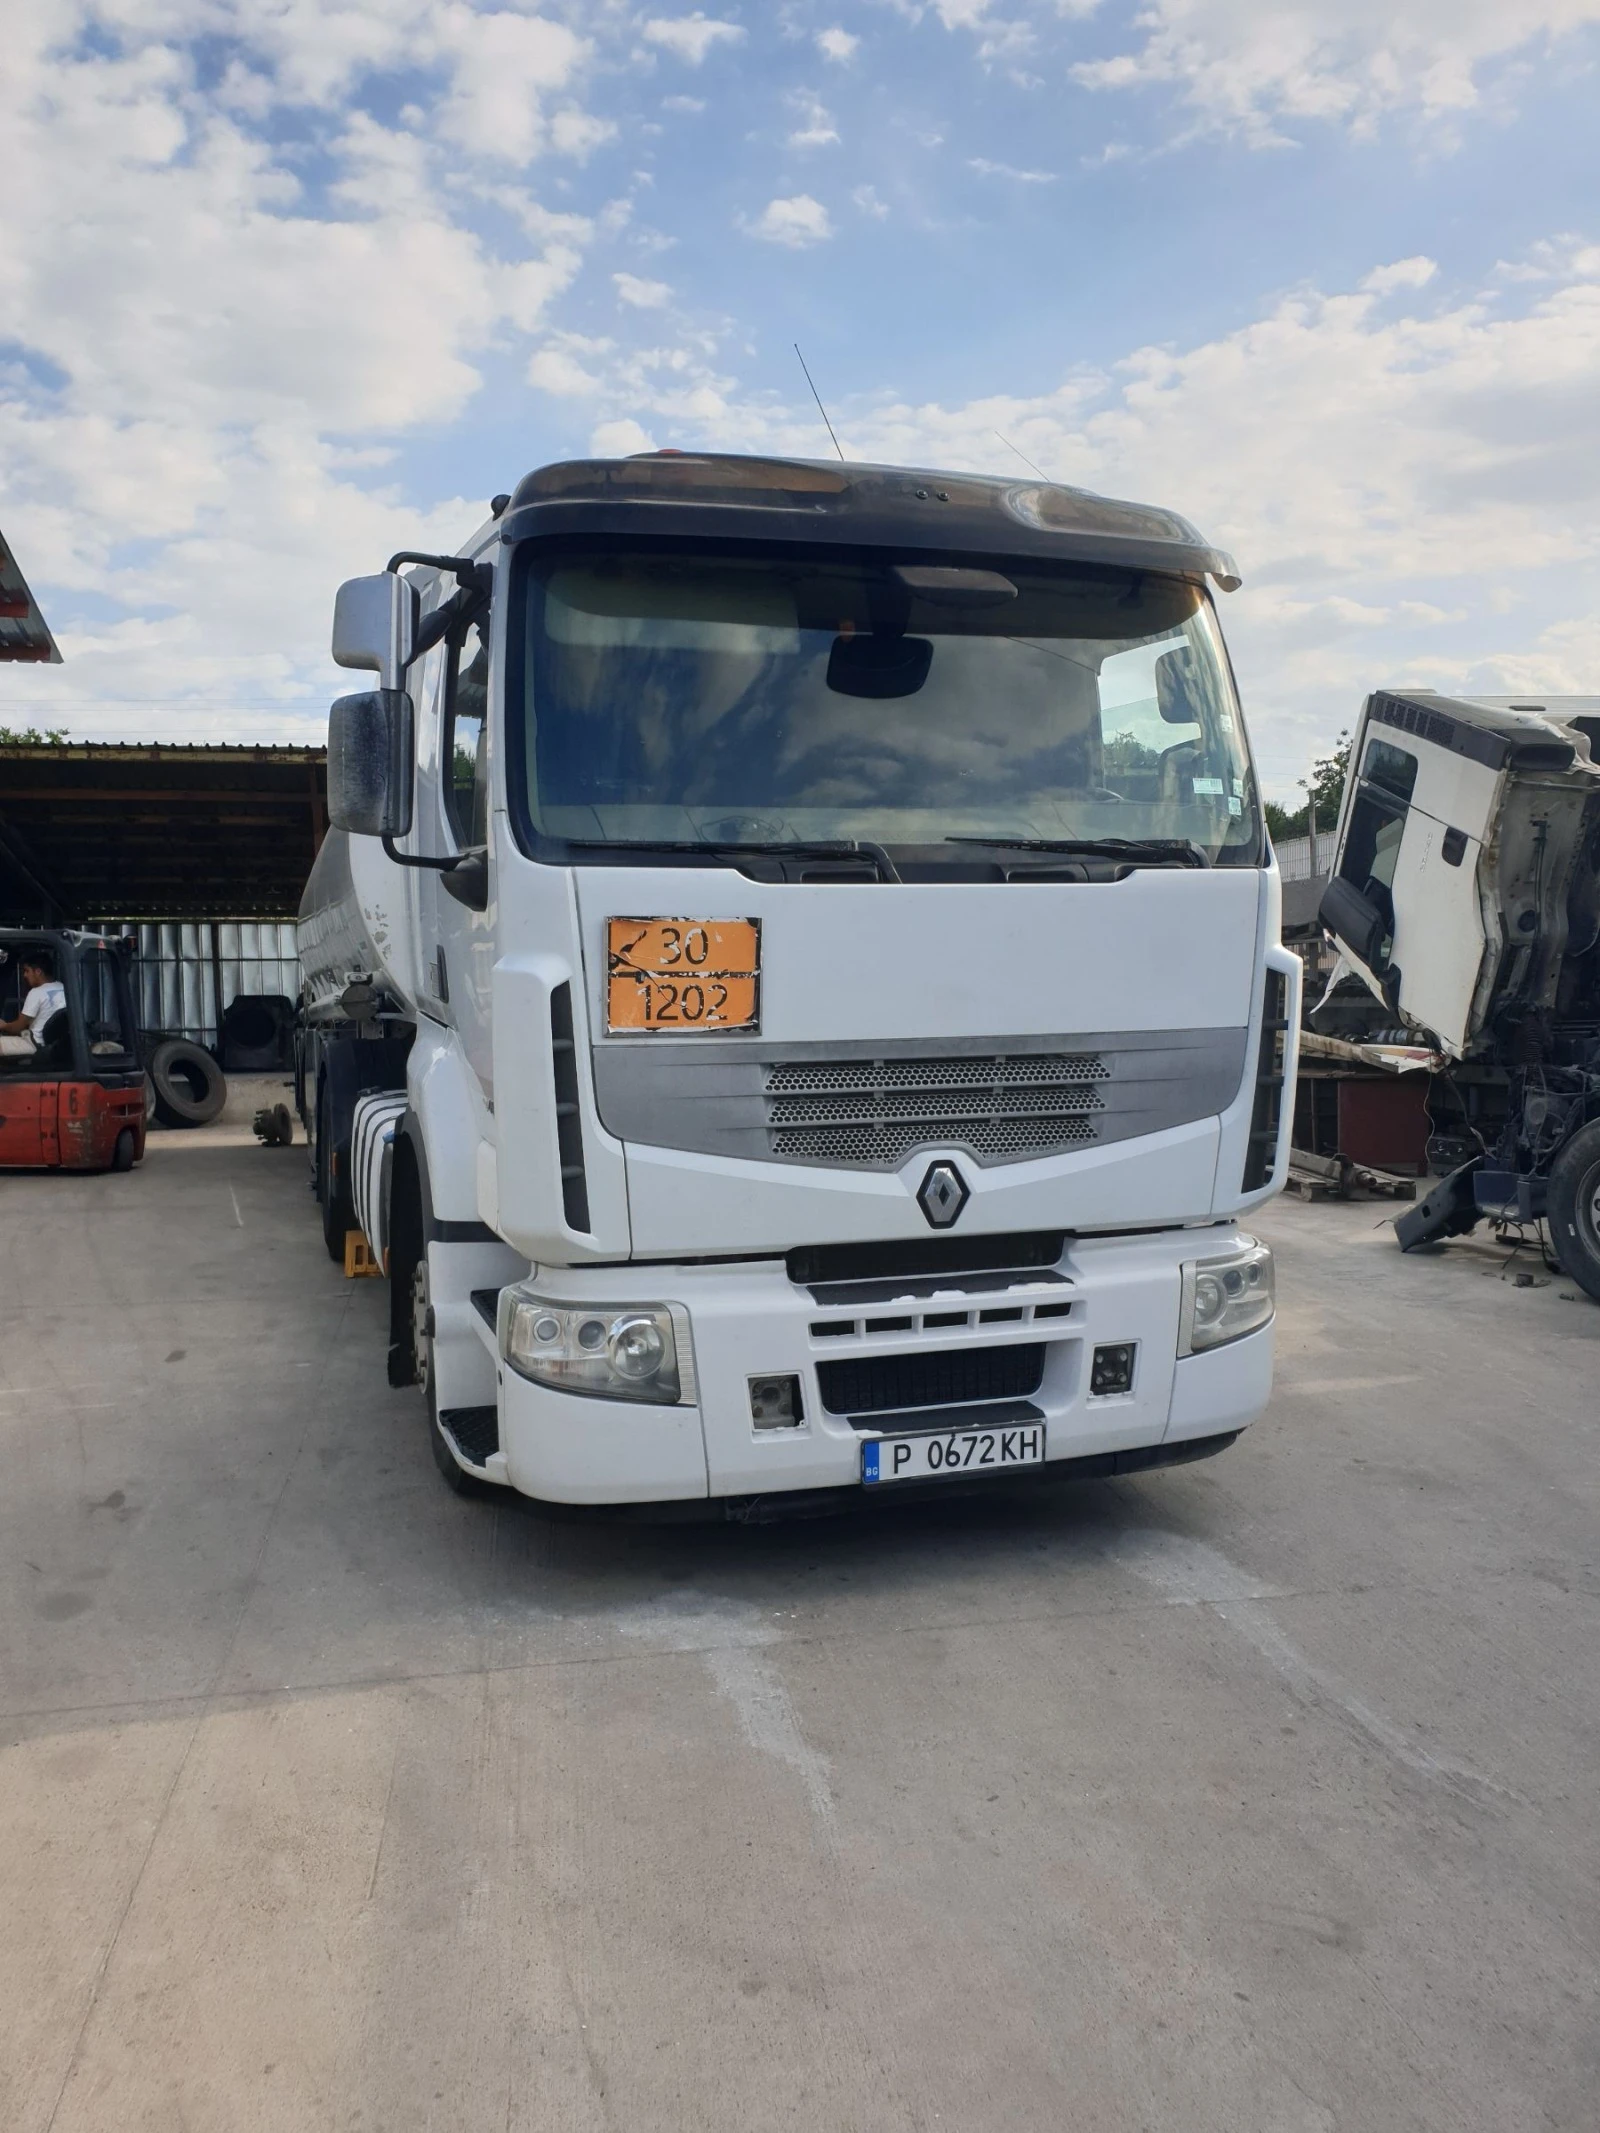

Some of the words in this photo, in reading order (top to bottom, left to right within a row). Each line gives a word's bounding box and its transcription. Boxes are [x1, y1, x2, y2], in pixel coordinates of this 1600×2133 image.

[660, 928, 708, 964] 30
[638, 984, 728, 1020] 1202
[866, 1467, 878, 1476] BG
[893, 1444, 911, 1474] P
